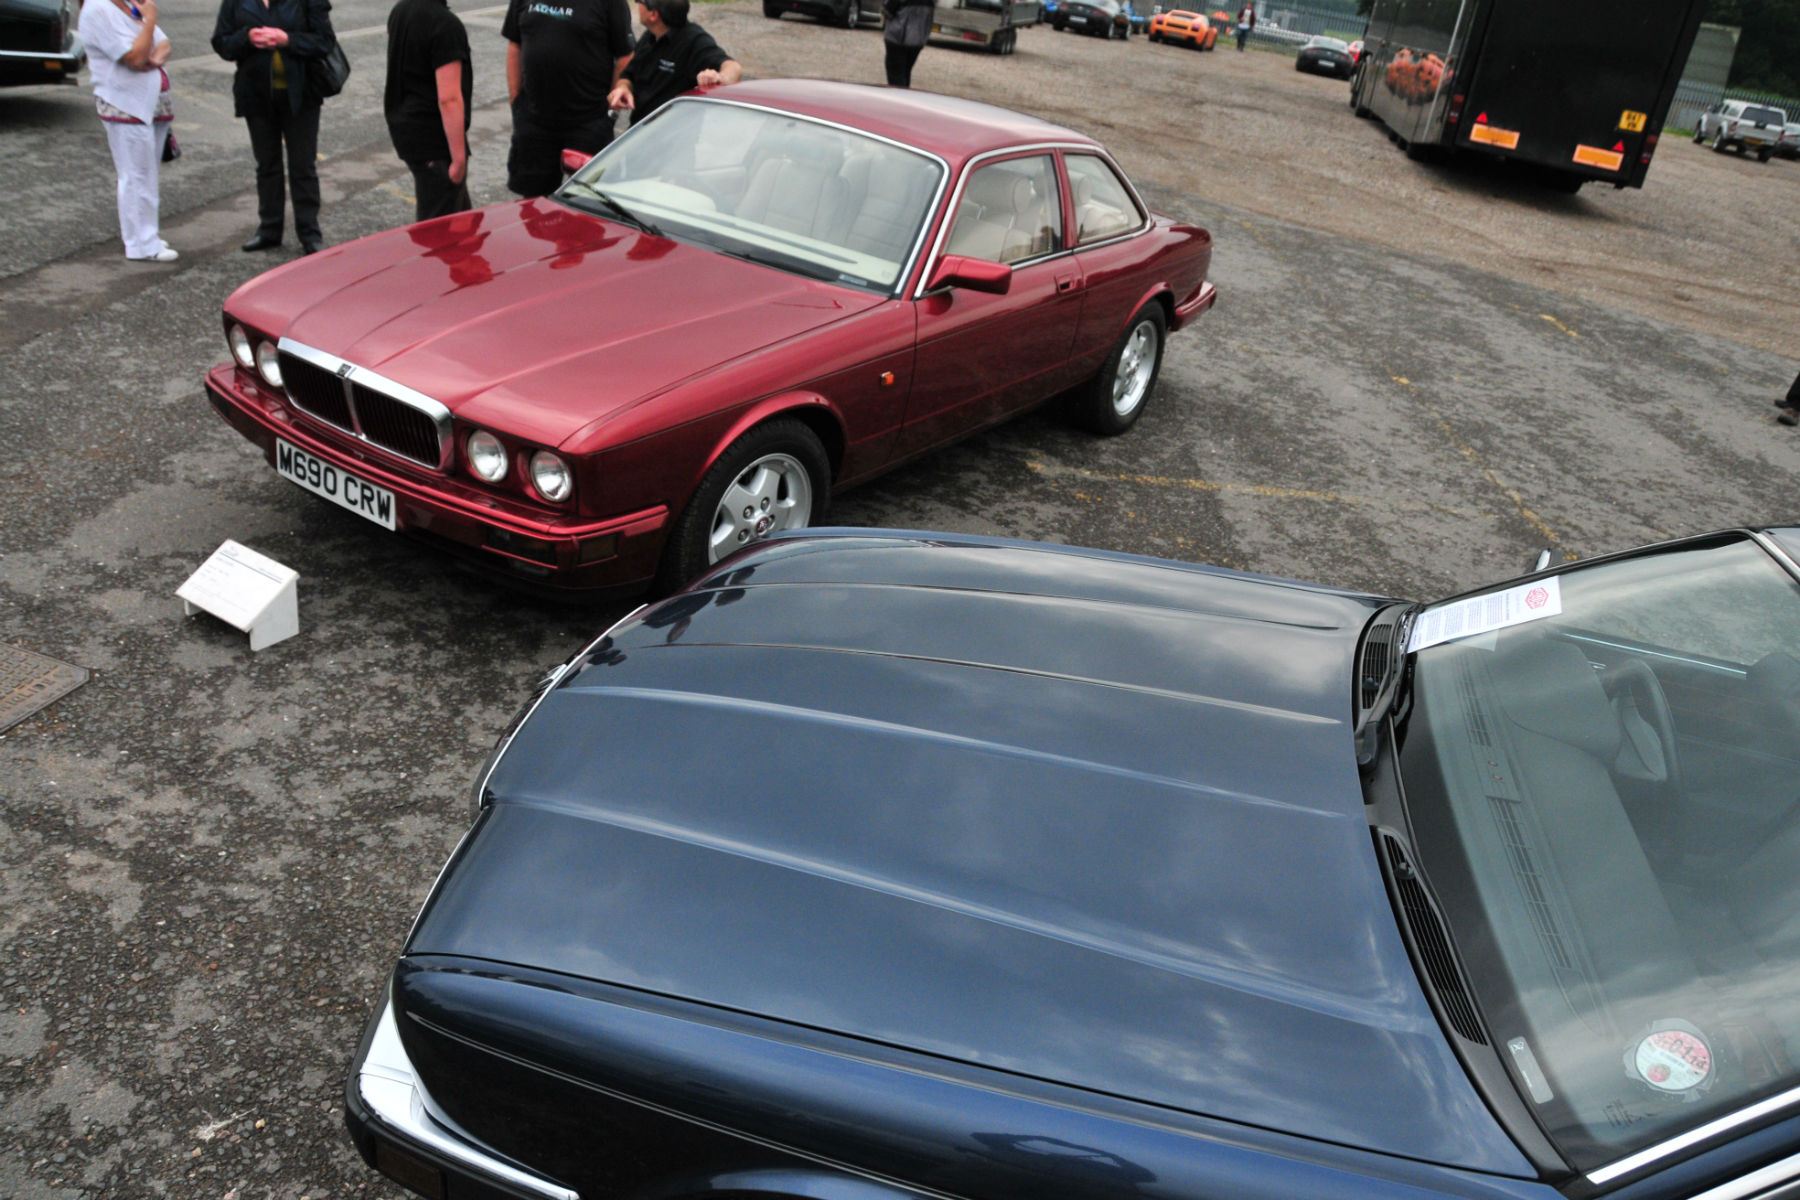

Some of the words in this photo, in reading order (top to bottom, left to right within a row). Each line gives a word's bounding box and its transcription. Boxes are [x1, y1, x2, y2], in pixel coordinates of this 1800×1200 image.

[528, 4, 574, 16] JAGUAR
[279, 443, 337, 495] M690
[344, 477, 391, 522] CRW
